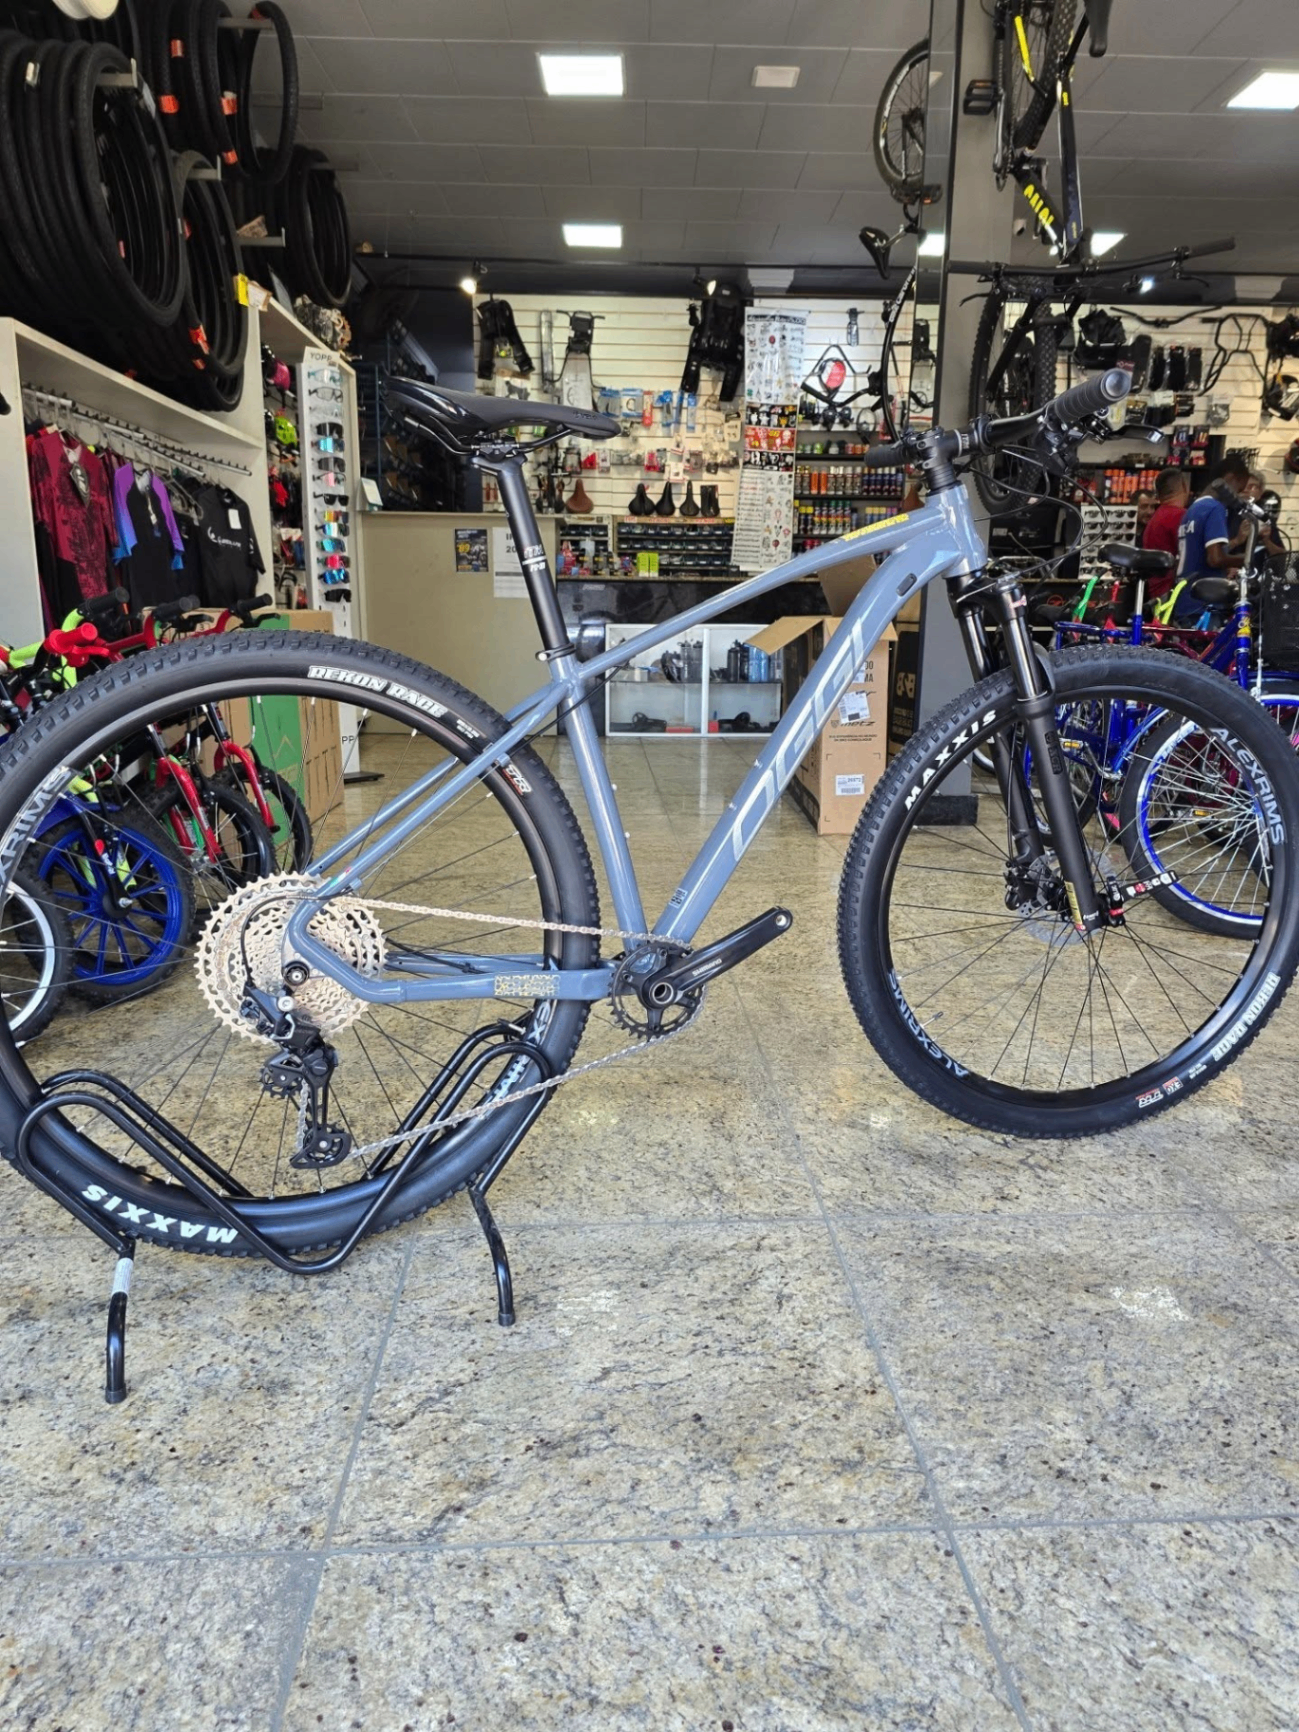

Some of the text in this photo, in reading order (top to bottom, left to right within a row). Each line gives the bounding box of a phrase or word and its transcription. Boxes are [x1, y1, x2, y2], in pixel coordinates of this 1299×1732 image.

[307, 665, 450, 718] REKON RACE
[732, 617, 864, 862] OGGI
[905, 710, 996, 811] MAXXIS
[1210, 728, 1285, 845] ALEXRIMS
[888, 967, 970, 1078] ALEXRIMS
[1209, 971, 1281, 1062] REKON RACE
[81, 1184, 238, 1243] MAXXIS
